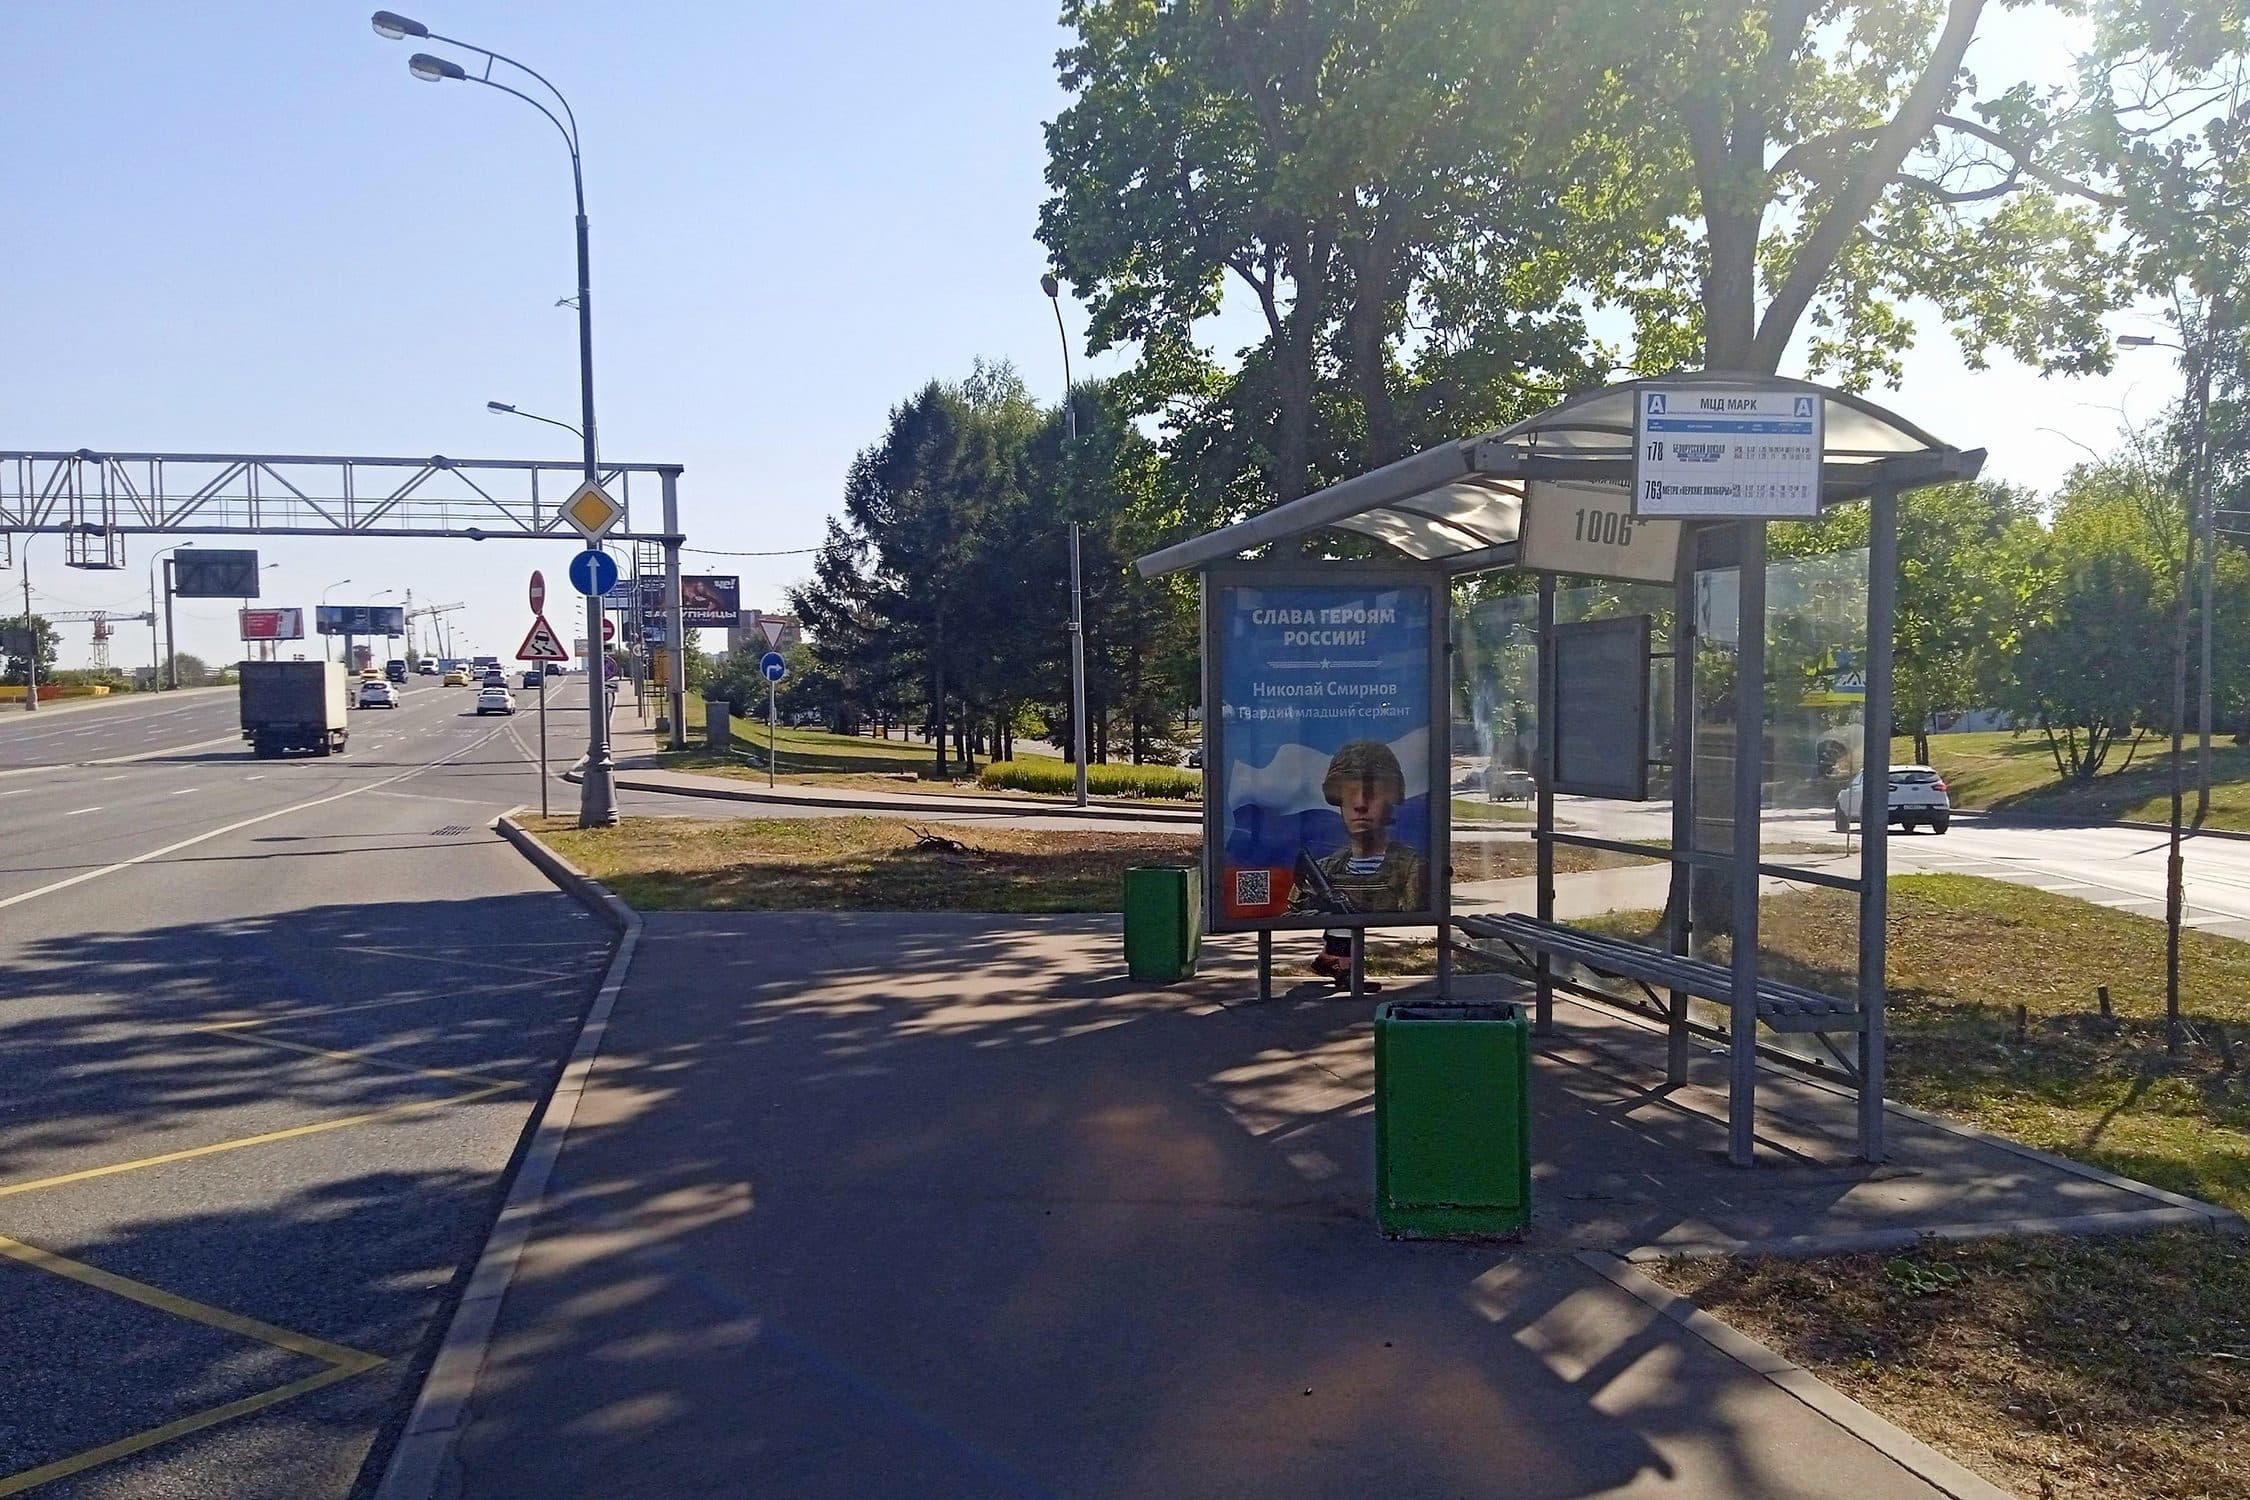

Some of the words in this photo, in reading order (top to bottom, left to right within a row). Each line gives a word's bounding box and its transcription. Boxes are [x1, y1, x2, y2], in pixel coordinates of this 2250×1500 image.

[1648, 395, 1665, 414] А
[1700, 398, 1725, 411] МЦД
[1727, 399, 1757, 411] МАРК
[1796, 398, 1812, 417] А
[1647, 441, 1664, 461] т78
[1645, 480, 1662, 499] 763
[1252, 608, 1316, 624] СЛАВА
[1320, 608, 1396, 624] ГЕРОЯМ
[1284, 630, 1366, 646] РОССИИ!
[1253, 680, 1324, 697] Николай
[1327, 681, 1398, 699] Смирнов
[1295, 703, 1356, 718] младший
[1358, 706, 1411, 719] сержант
